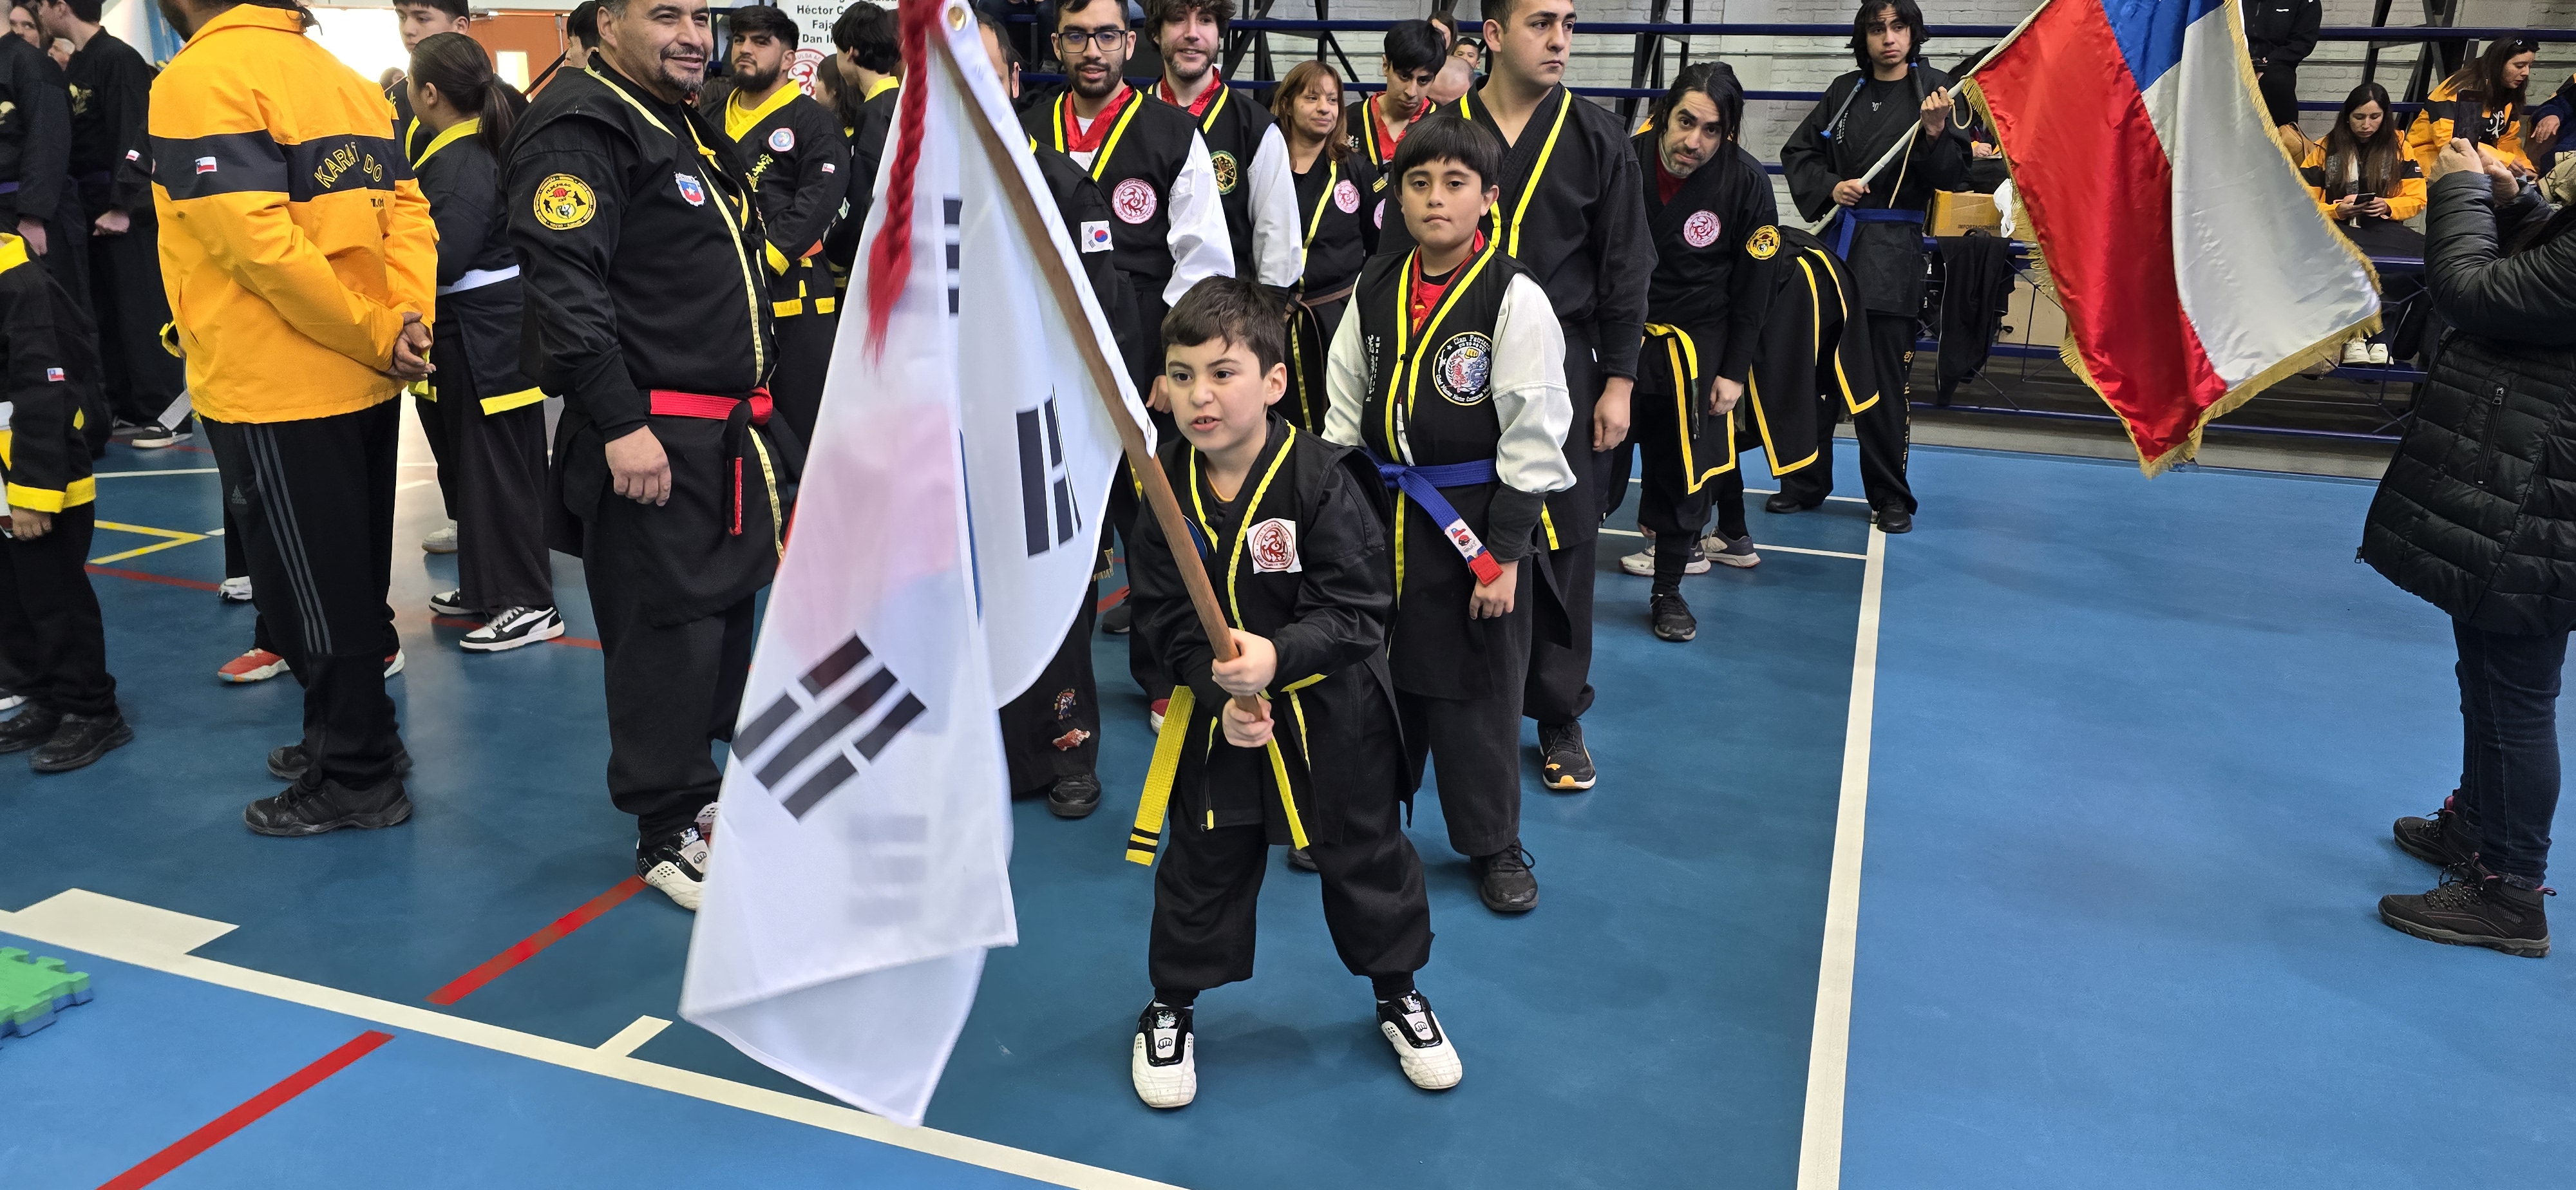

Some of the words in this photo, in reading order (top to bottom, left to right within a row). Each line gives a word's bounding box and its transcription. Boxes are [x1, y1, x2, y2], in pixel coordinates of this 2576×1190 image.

[797, 5, 833, 15] Héctor
[802, 34, 822, 43] Dan
[314, 142, 359, 189] KARAT
[363, 154, 383, 182] DO
